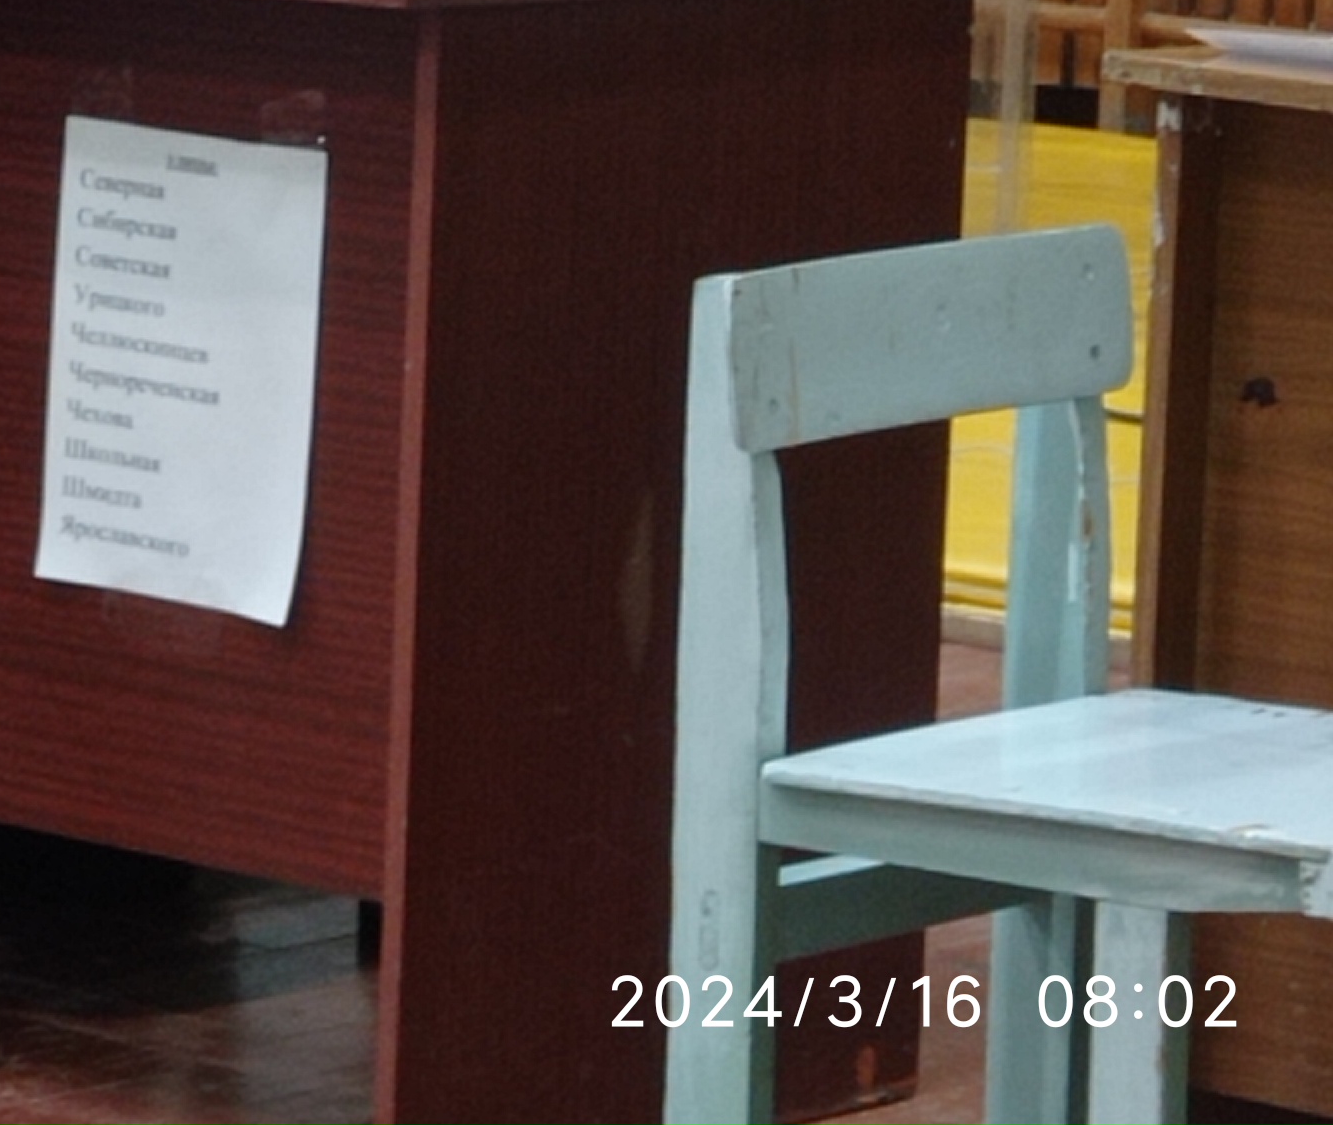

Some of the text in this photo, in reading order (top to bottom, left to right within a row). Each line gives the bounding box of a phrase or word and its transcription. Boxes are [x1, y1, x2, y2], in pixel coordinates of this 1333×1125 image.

[80, 168, 165, 200] Северная
[77, 207, 177, 239] Сибирская
[75, 245, 171, 278] Советская
[73, 282, 166, 317] Урицкого
[69, 359, 221, 405] Чернореченская
[67, 398, 134, 430] Чехова
[64, 436, 161, 473] Школьная
[61, 475, 143, 509] Шмидта
[59, 514, 190, 557] Ярославского
